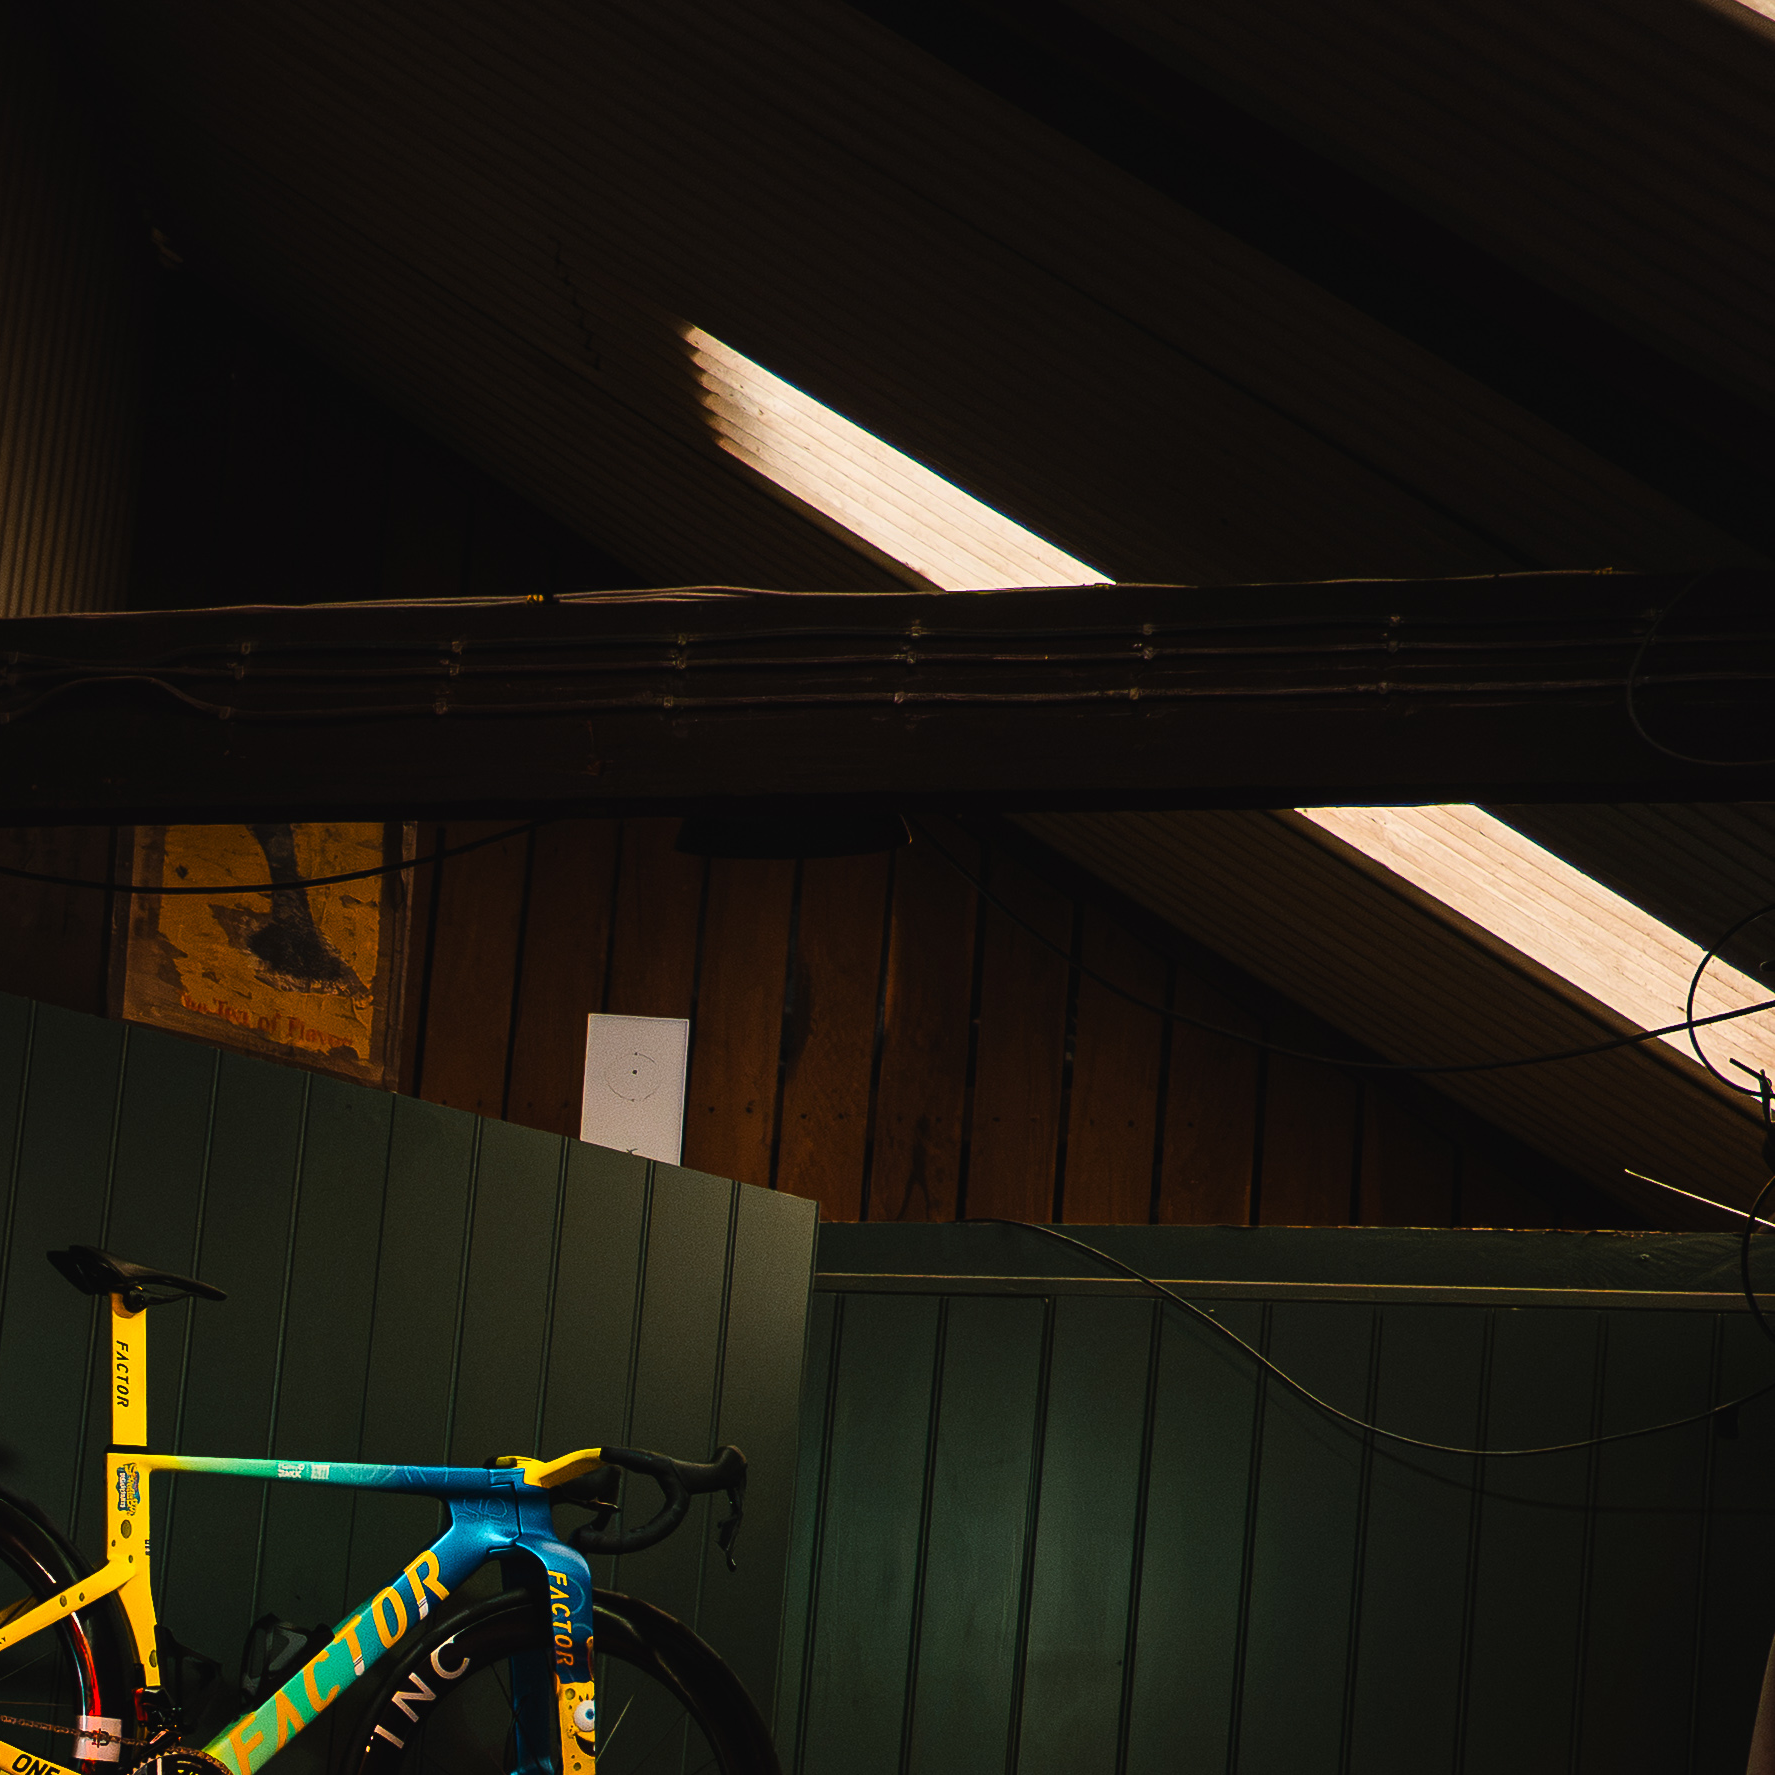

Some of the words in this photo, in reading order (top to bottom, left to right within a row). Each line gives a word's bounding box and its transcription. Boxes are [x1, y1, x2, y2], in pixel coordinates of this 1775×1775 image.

[116, 1340, 130, 1407] FACTOR
[548, 1569, 574, 1667] FACTOR
[374, 1636, 471, 1749] INC
